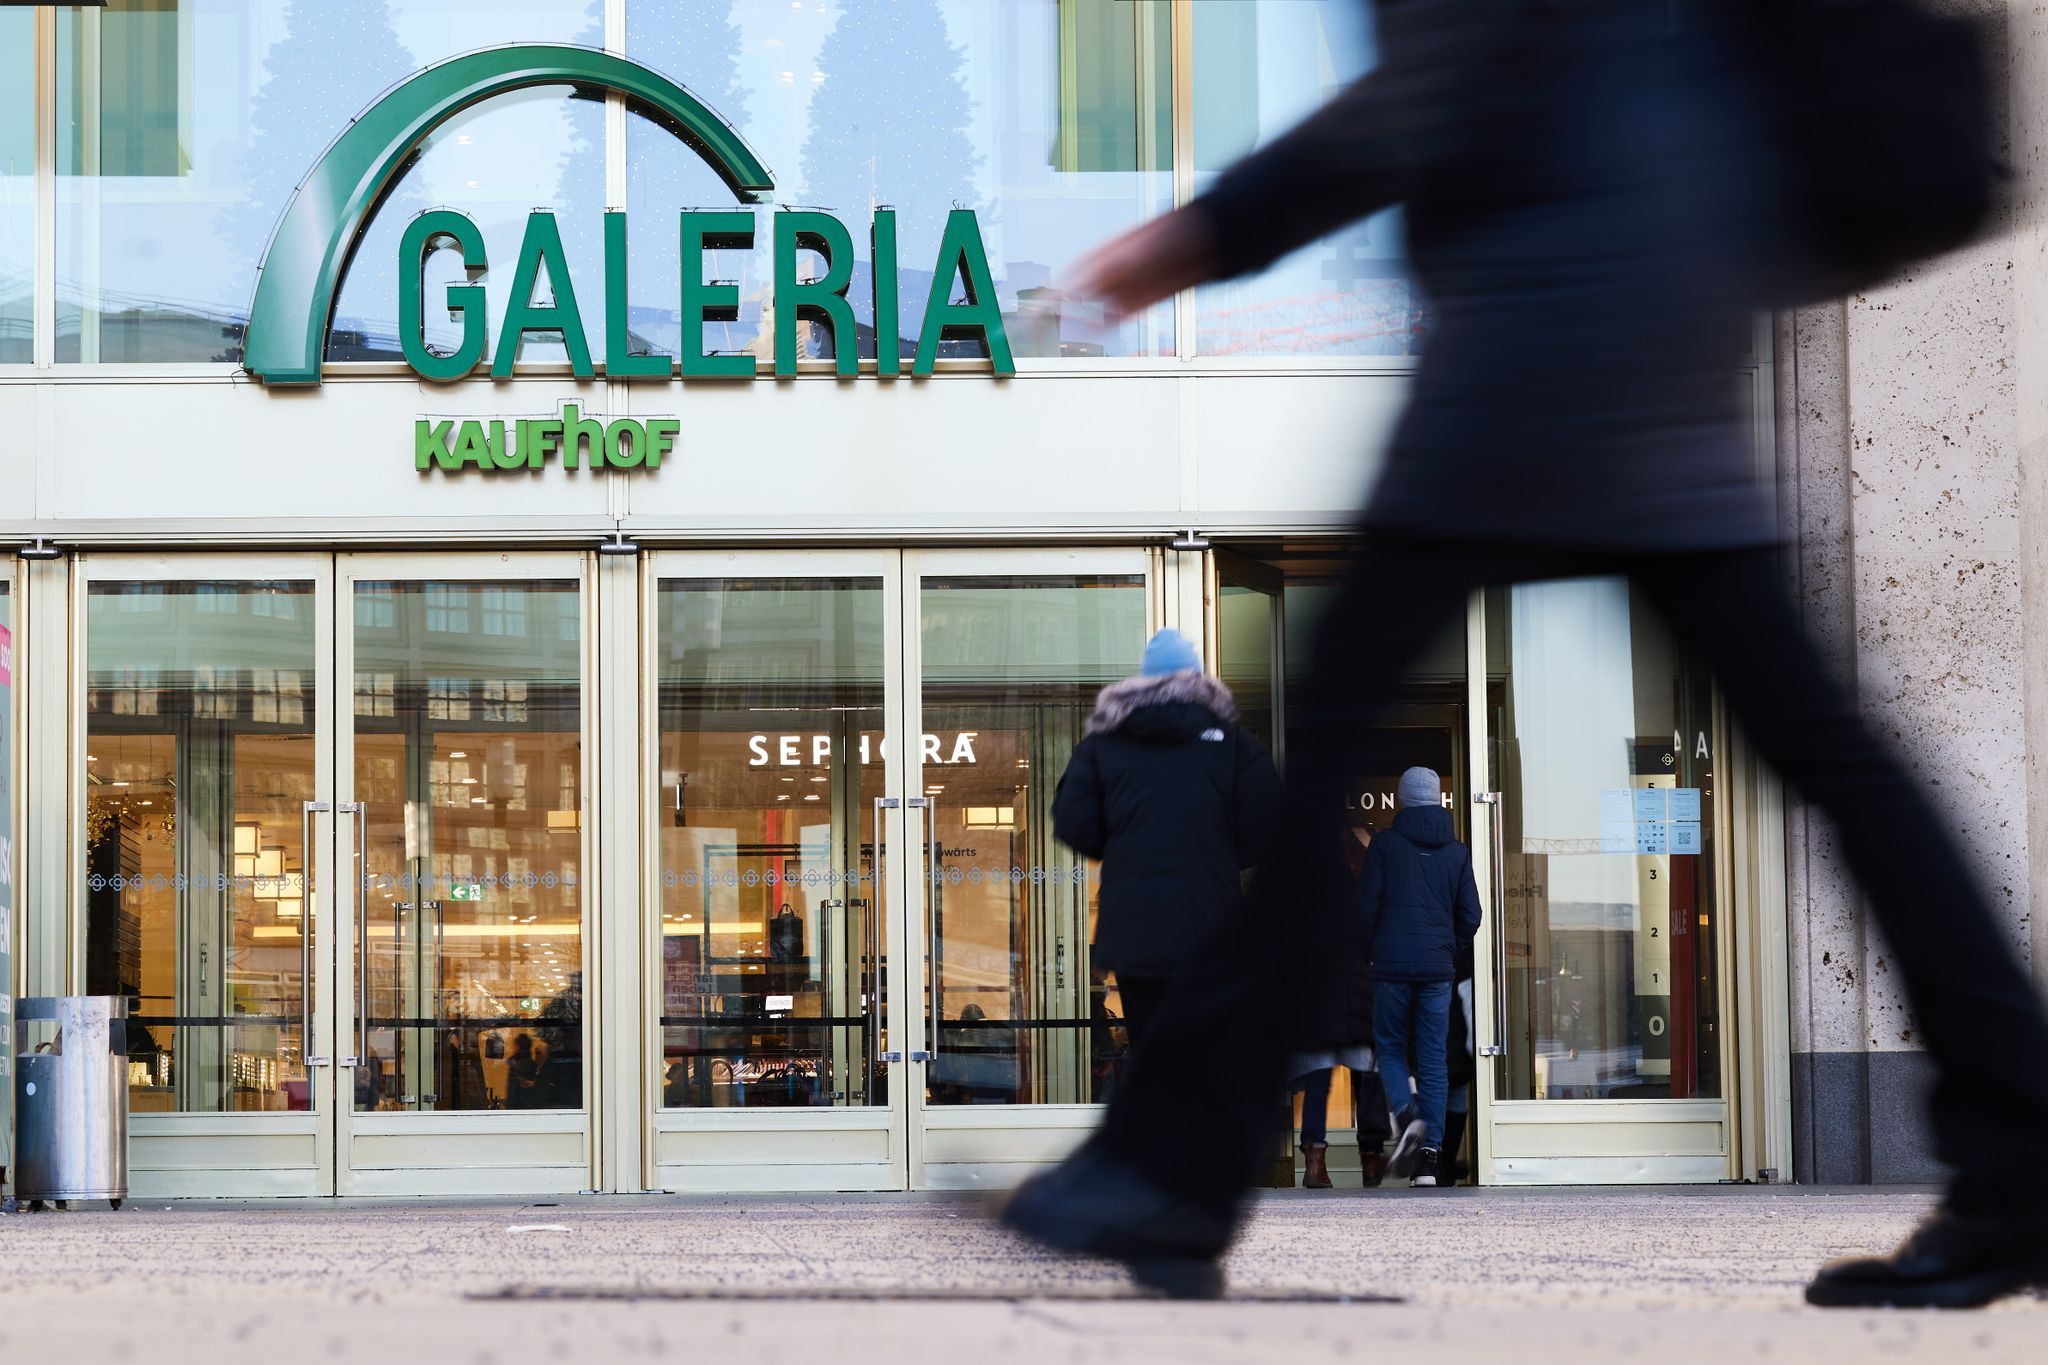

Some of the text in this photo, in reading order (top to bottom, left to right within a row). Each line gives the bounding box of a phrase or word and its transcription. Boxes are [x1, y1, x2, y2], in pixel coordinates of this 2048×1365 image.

[399, 209, 1016, 382] GALERIA
[749, 733, 977, 765] SEPHRA
[1345, 792, 1453, 810] LONH
[941, 847, 977, 857] wärts
[1649, 869, 1657, 880] 3
[1671, 910, 1688, 936] SALE
[1650, 927, 1658, 938] 2
[1653, 973, 1659, 984] 1
